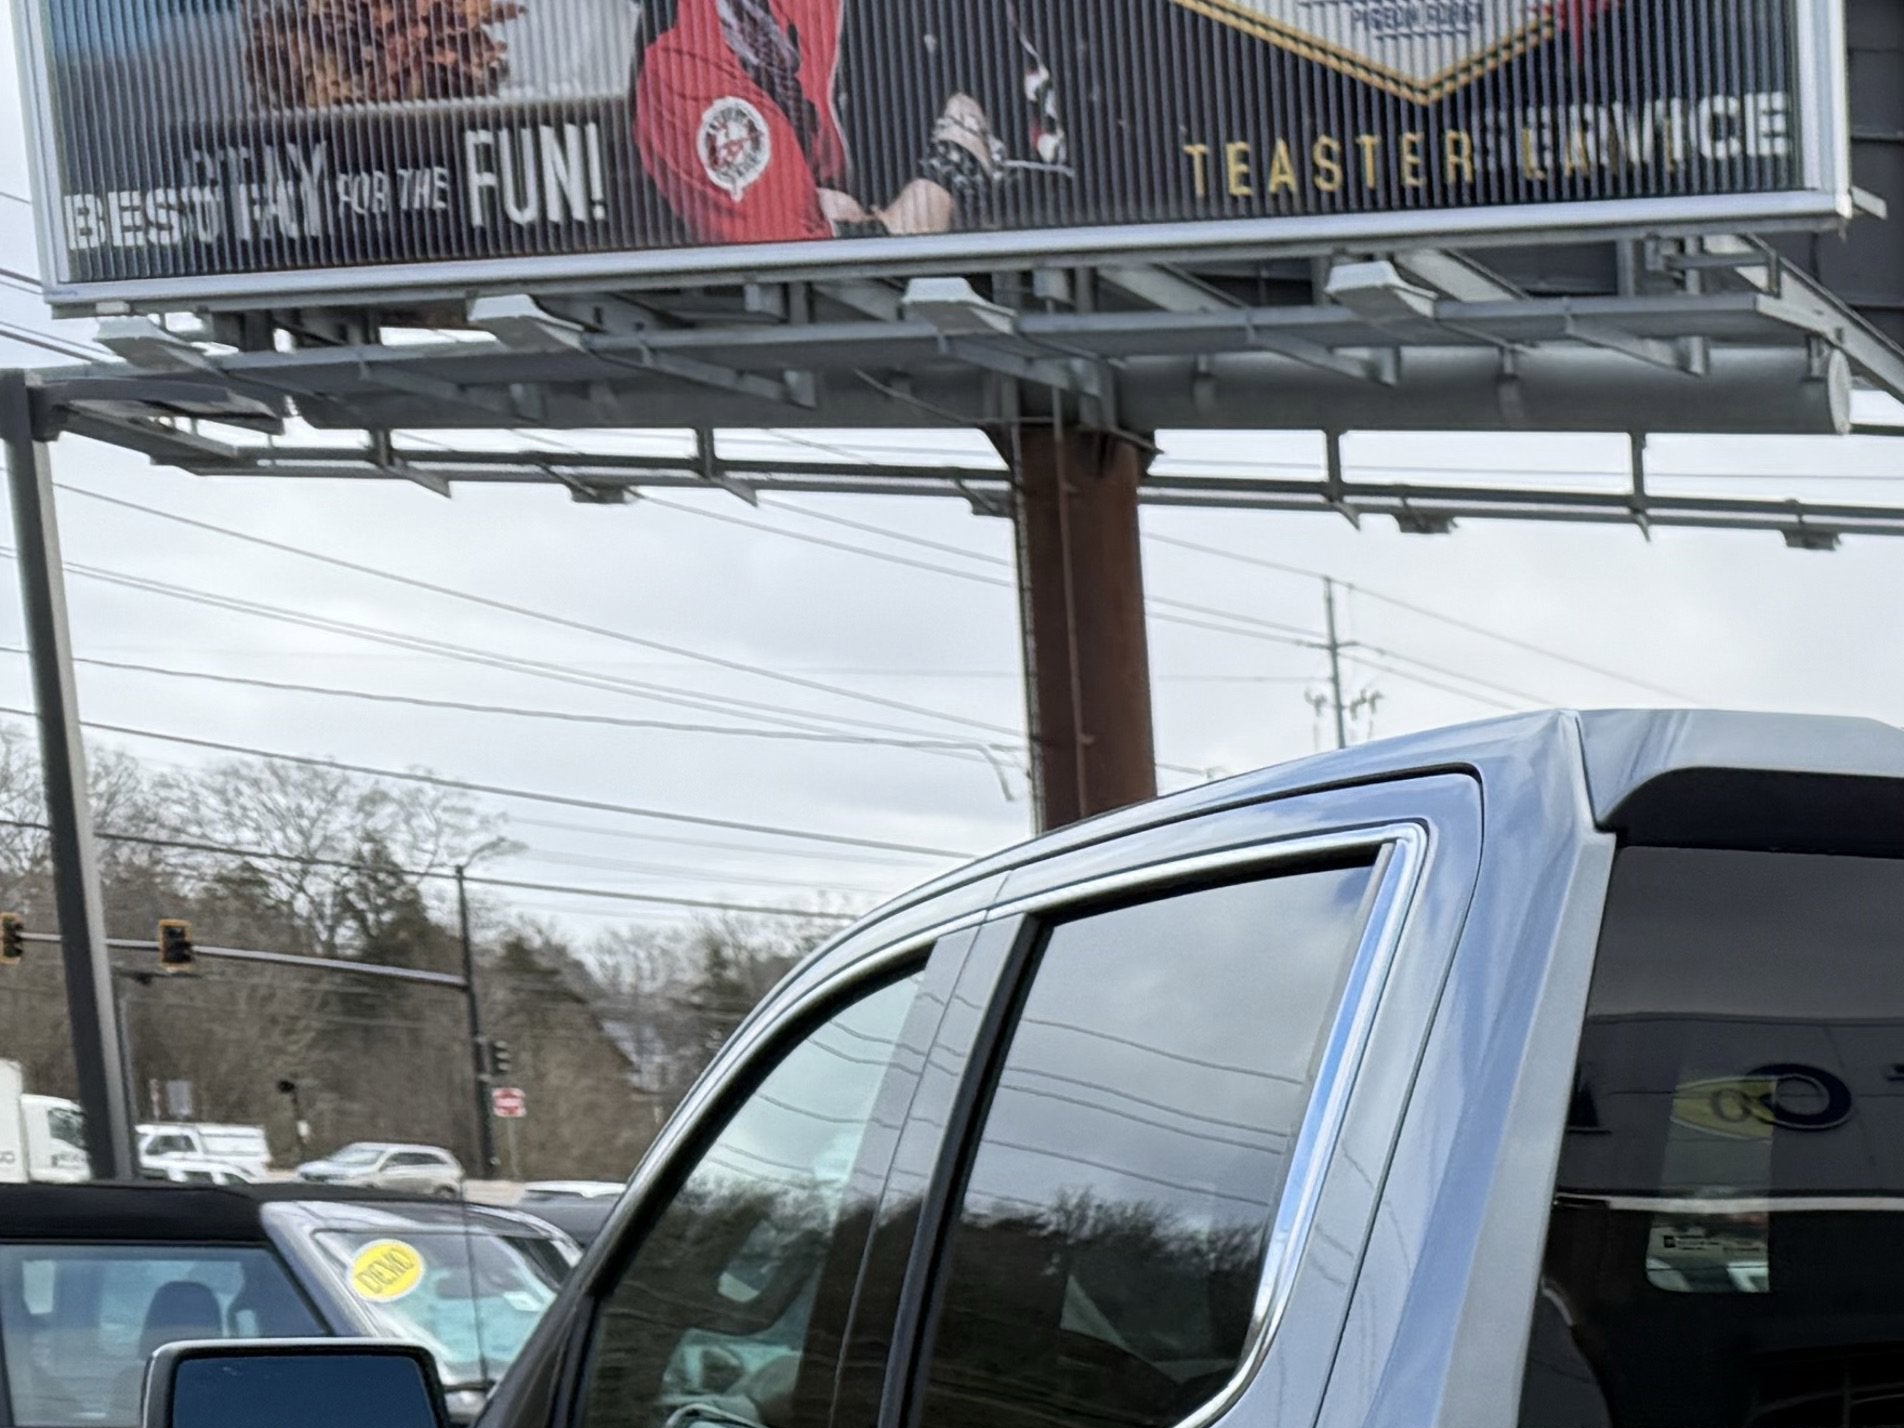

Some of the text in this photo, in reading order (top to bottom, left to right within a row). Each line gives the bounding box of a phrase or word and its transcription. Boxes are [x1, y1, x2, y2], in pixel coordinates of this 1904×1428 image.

[338, 170, 389, 216] FOR
[398, 166, 450, 213] THE
[463, 121, 609, 229] FUN!
